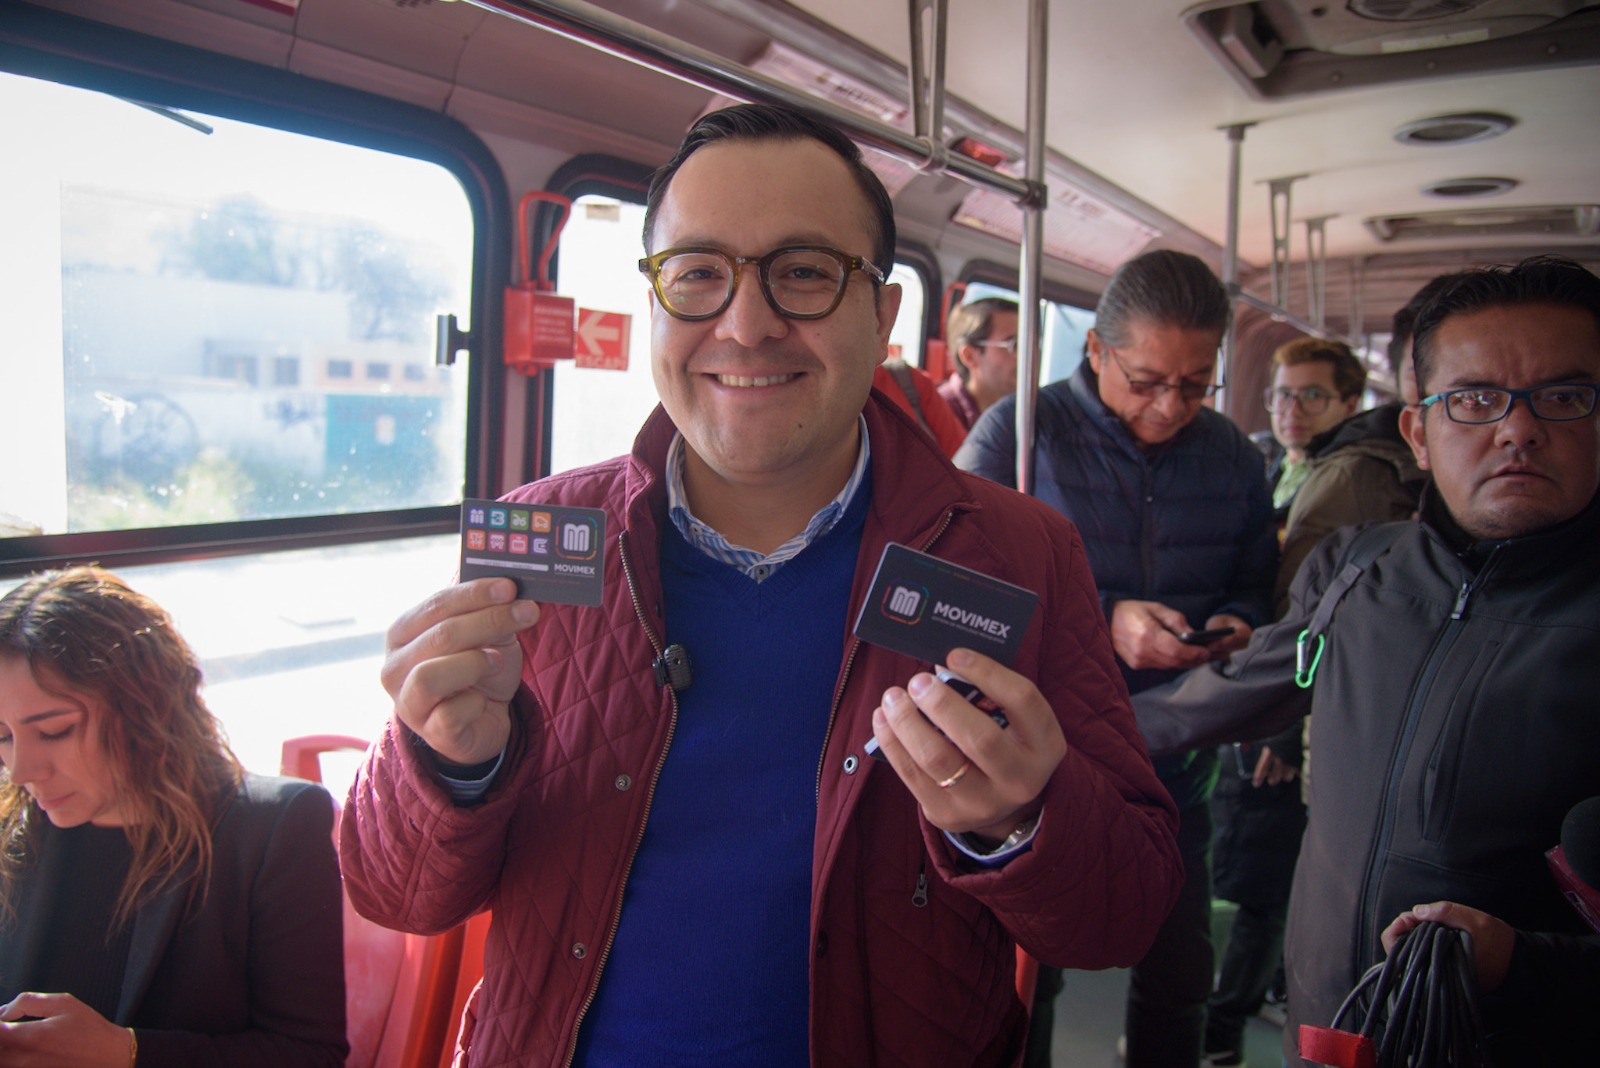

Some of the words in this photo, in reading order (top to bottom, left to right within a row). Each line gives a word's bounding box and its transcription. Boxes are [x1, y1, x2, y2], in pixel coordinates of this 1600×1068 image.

[576, 354, 628, 370] ESCAP
[554, 563, 595, 575] MOVIMEX
[933, 601, 1011, 638] MOVIMEX
